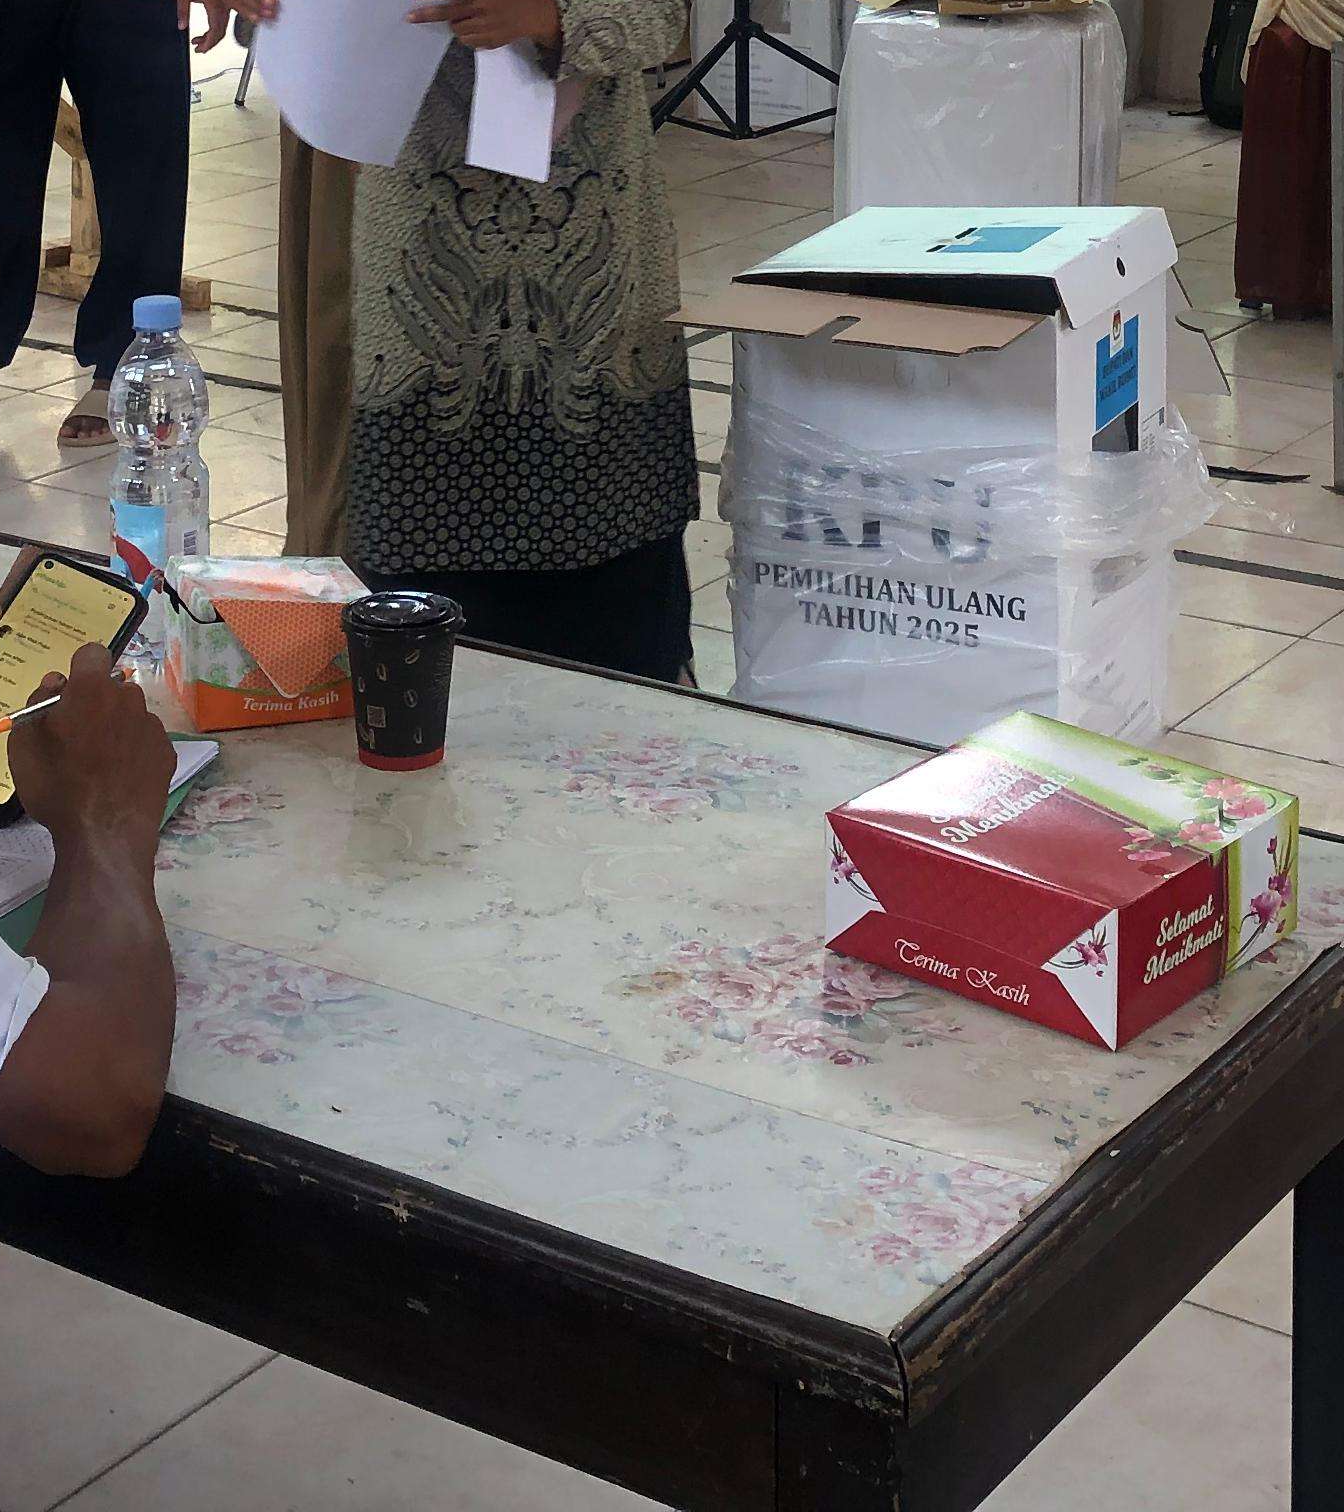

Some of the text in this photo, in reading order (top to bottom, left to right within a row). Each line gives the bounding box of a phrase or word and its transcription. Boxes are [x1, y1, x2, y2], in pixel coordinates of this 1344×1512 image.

[755, 562, 1027, 622] PEMILIHAN ULANG
[798, 600, 981, 648] TAHUN 2025
[243, 690, 340, 712] Terima Kasih
[940, 774, 1075, 843] Menikmati
[1143, 915, 1224, 985] Menikmati
[1156, 894, 1214, 947] Selamat
[894, 938, 1030, 1006] Terima Kasih
